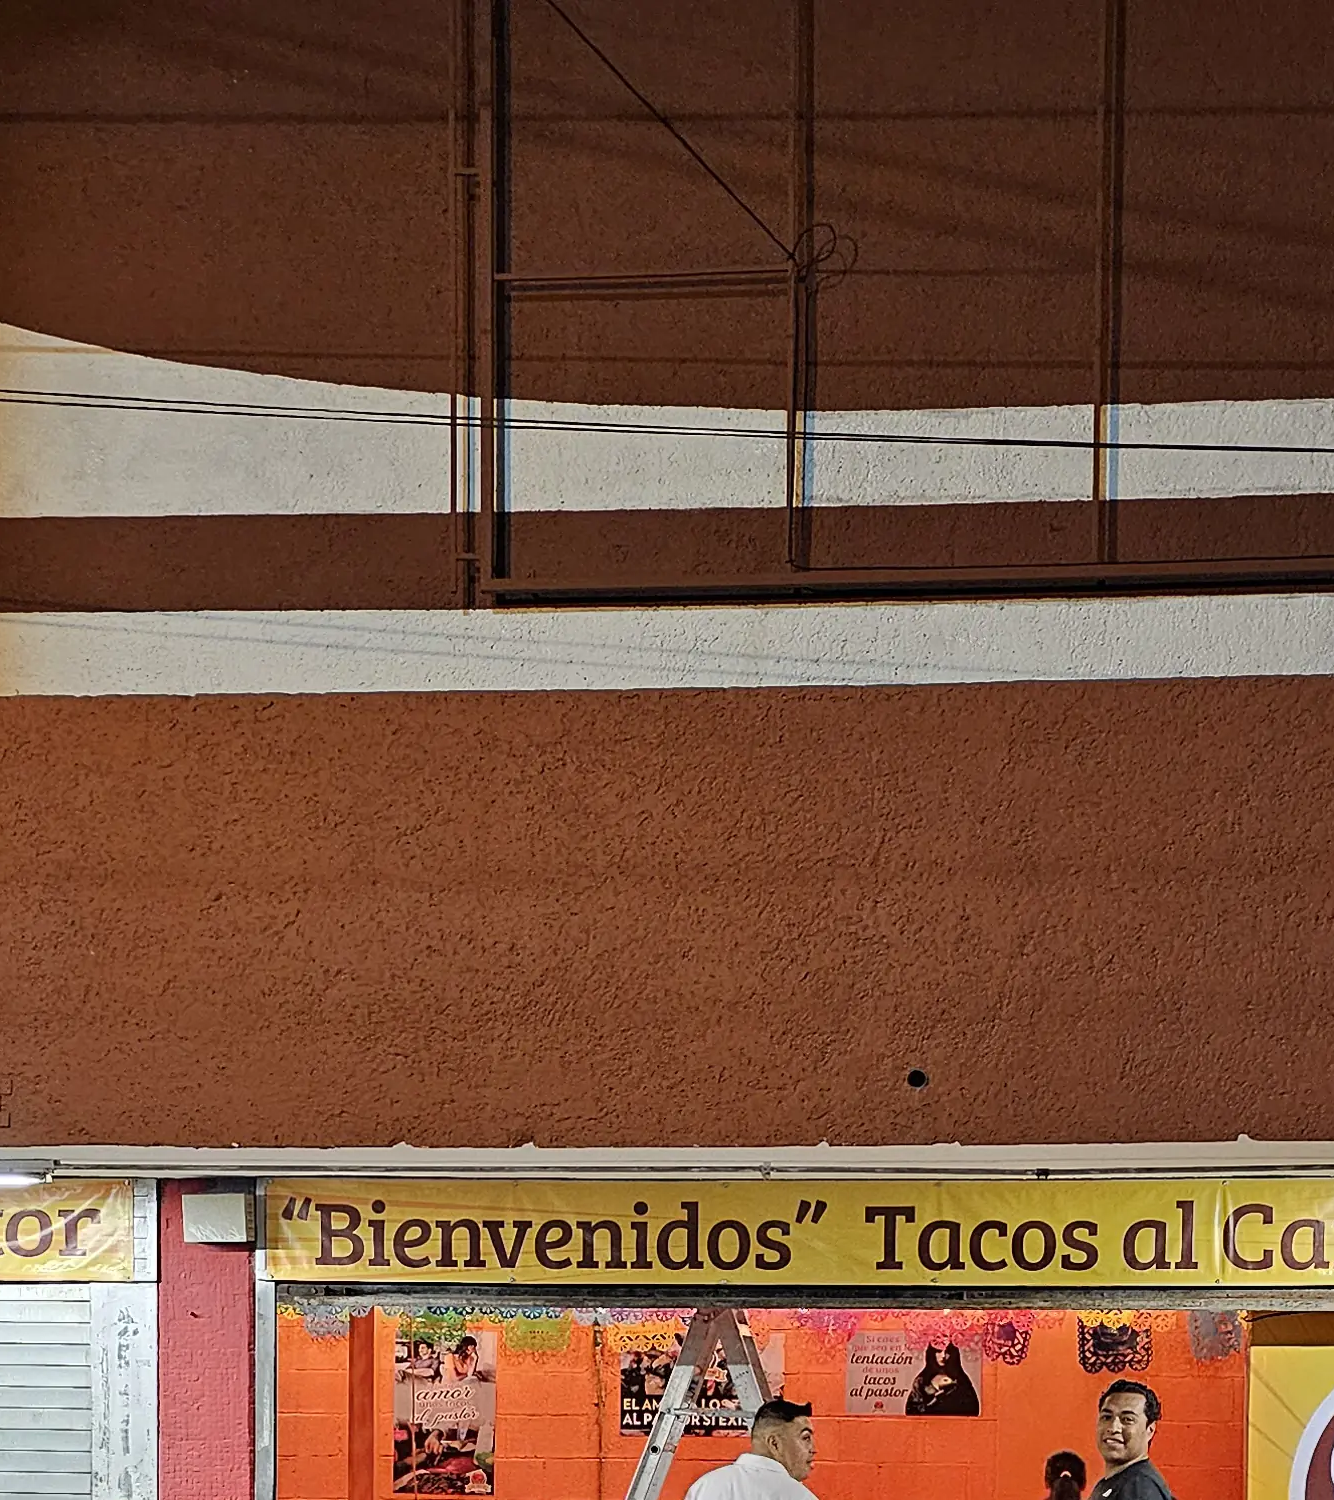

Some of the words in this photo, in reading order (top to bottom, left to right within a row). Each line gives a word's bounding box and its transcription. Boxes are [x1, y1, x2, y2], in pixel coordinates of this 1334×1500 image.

[865, 1206, 1099, 1271] Tacos
[1122, 1199, 1199, 1271] al
[850, 1352, 913, 1365] tentación
[863, 1374, 897, 1386] tacos
[416, 1386, 473, 1402] amor
[849, 1386, 864, 1398] al
[864, 1386, 909, 1400] pastor
[623, 1398, 641, 1410] EL
[431, 1407, 479, 1427] pastor
[622, 1412, 641, 1426] AL
